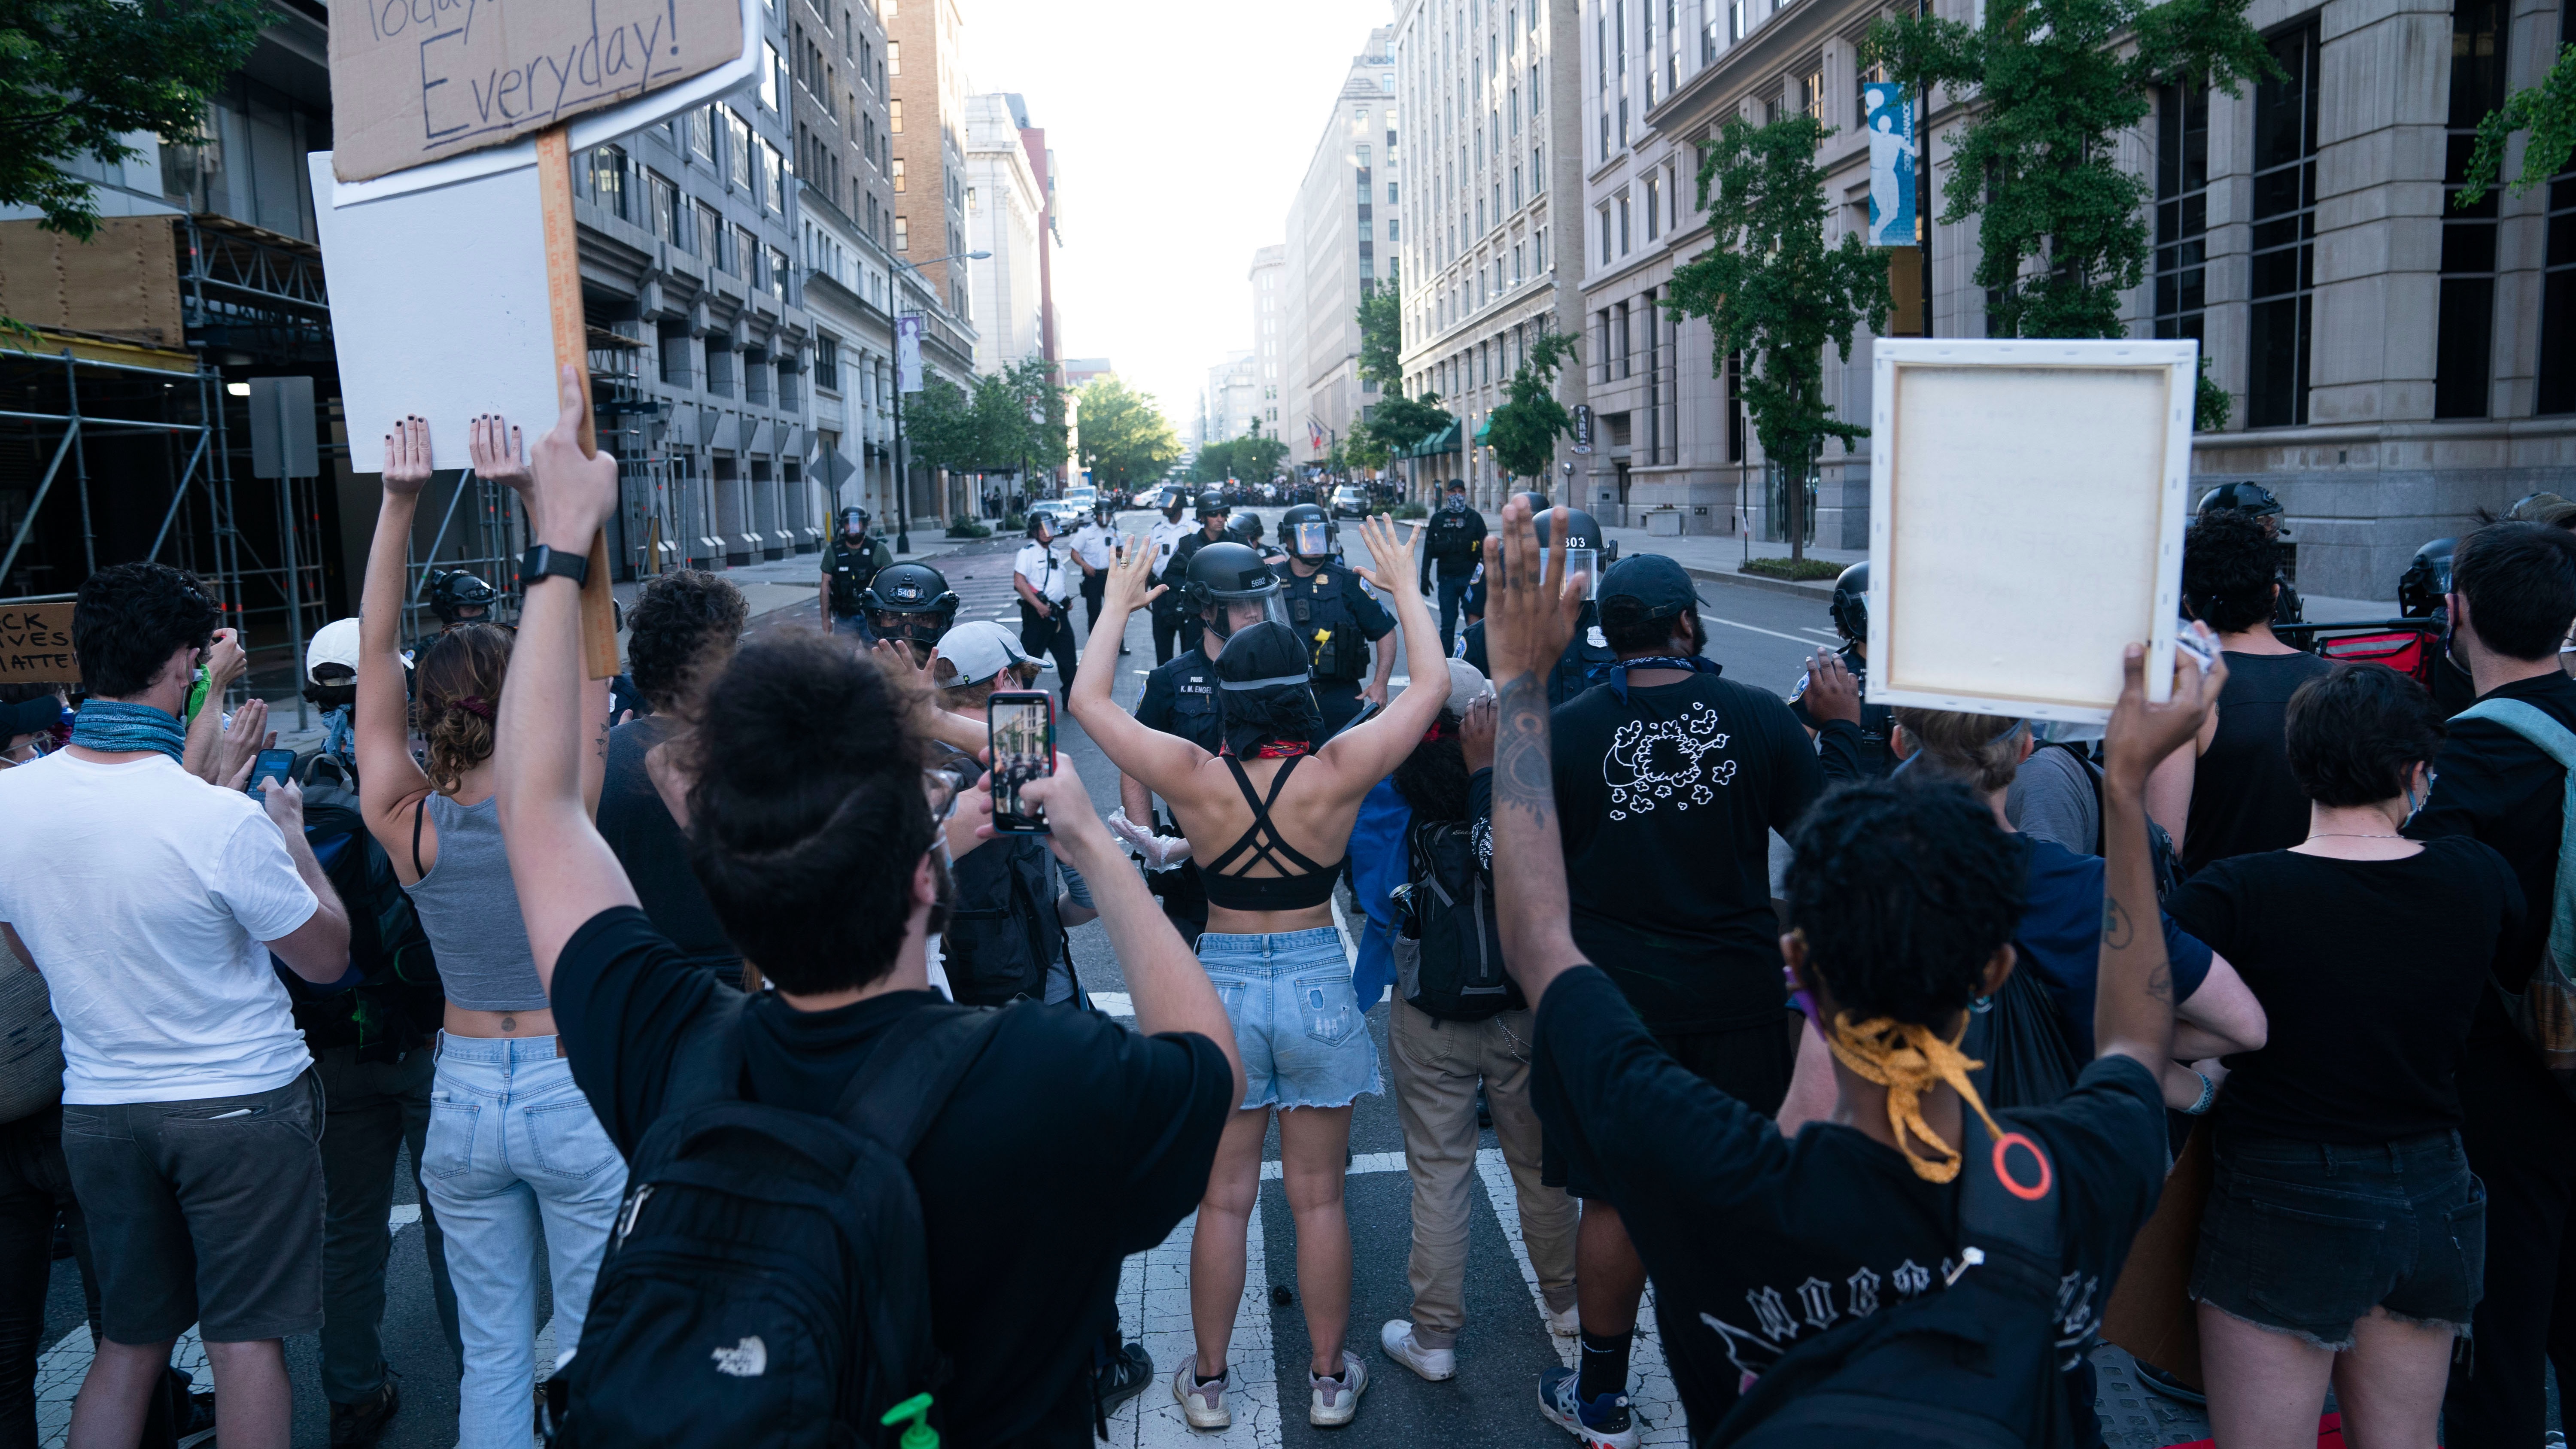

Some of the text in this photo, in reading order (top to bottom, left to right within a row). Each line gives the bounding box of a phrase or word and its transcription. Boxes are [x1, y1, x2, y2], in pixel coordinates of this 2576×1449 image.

[421, 0, 679, 138] Everyday!
[1252, 577, 1266, 587] 5692
[898, 589, 916, 597] 5403
[0, 613, 48, 633] CK
[0, 653, 79, 672] ATTE
[1195, 686, 1212, 694] ENGEL
